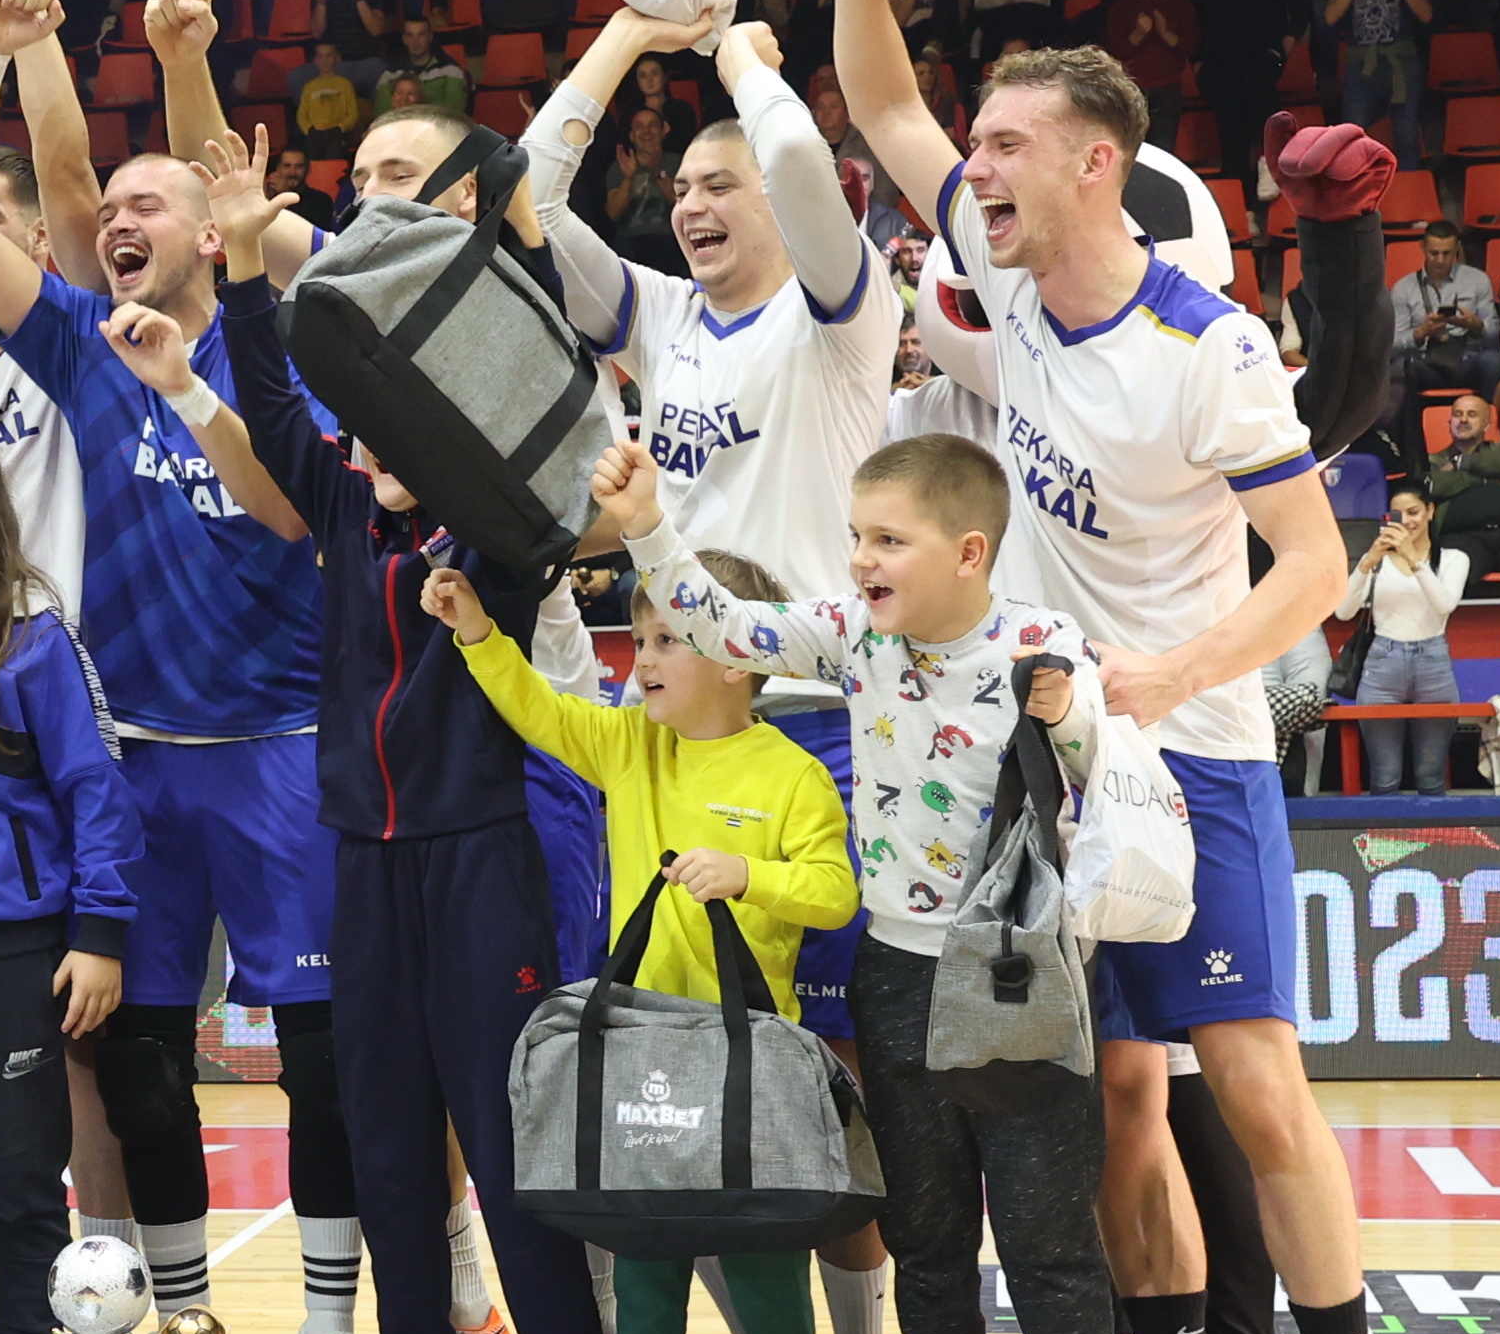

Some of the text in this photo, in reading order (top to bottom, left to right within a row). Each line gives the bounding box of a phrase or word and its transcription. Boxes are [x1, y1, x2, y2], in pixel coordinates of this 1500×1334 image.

[1006, 310, 1044, 364] KELME
[1234, 352, 1270, 374] KELME
[1025, 465, 1109, 541] KAL
[296, 954, 332, 967] KEL
[795, 982, 847, 999] ELME
[1200, 973, 1244, 987] KELME
[615, 1100, 706, 1129] MAXBET
